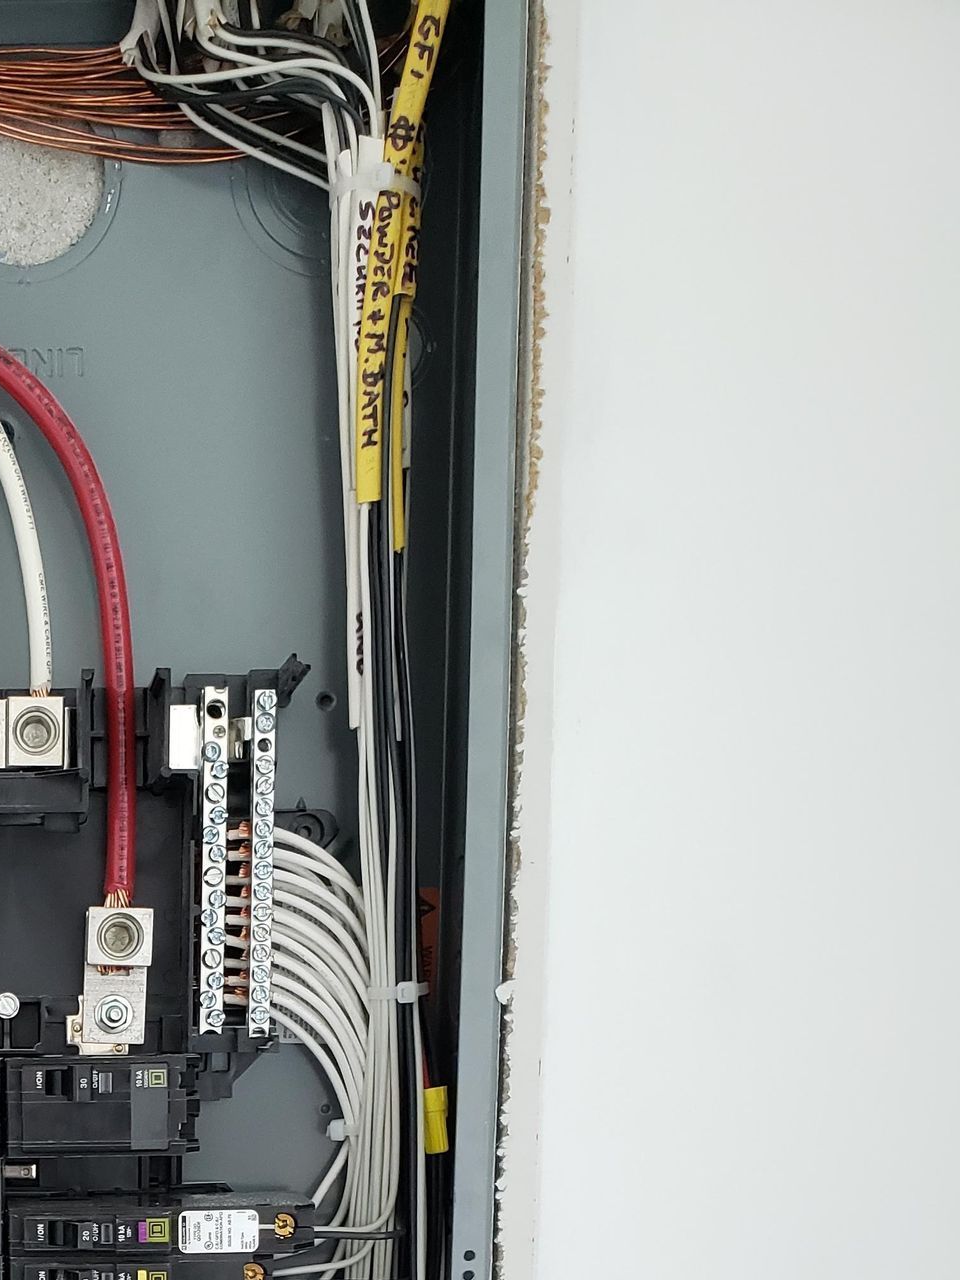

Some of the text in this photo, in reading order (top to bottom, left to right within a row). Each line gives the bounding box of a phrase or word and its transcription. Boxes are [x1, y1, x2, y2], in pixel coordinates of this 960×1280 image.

[371, 190, 401, 300] POWDER
[366, 308, 386, 326] +
[360, 363, 384, 449] BATH
[80, 1078, 88, 1088] 30
[83, 1231, 89, 1241] 20
